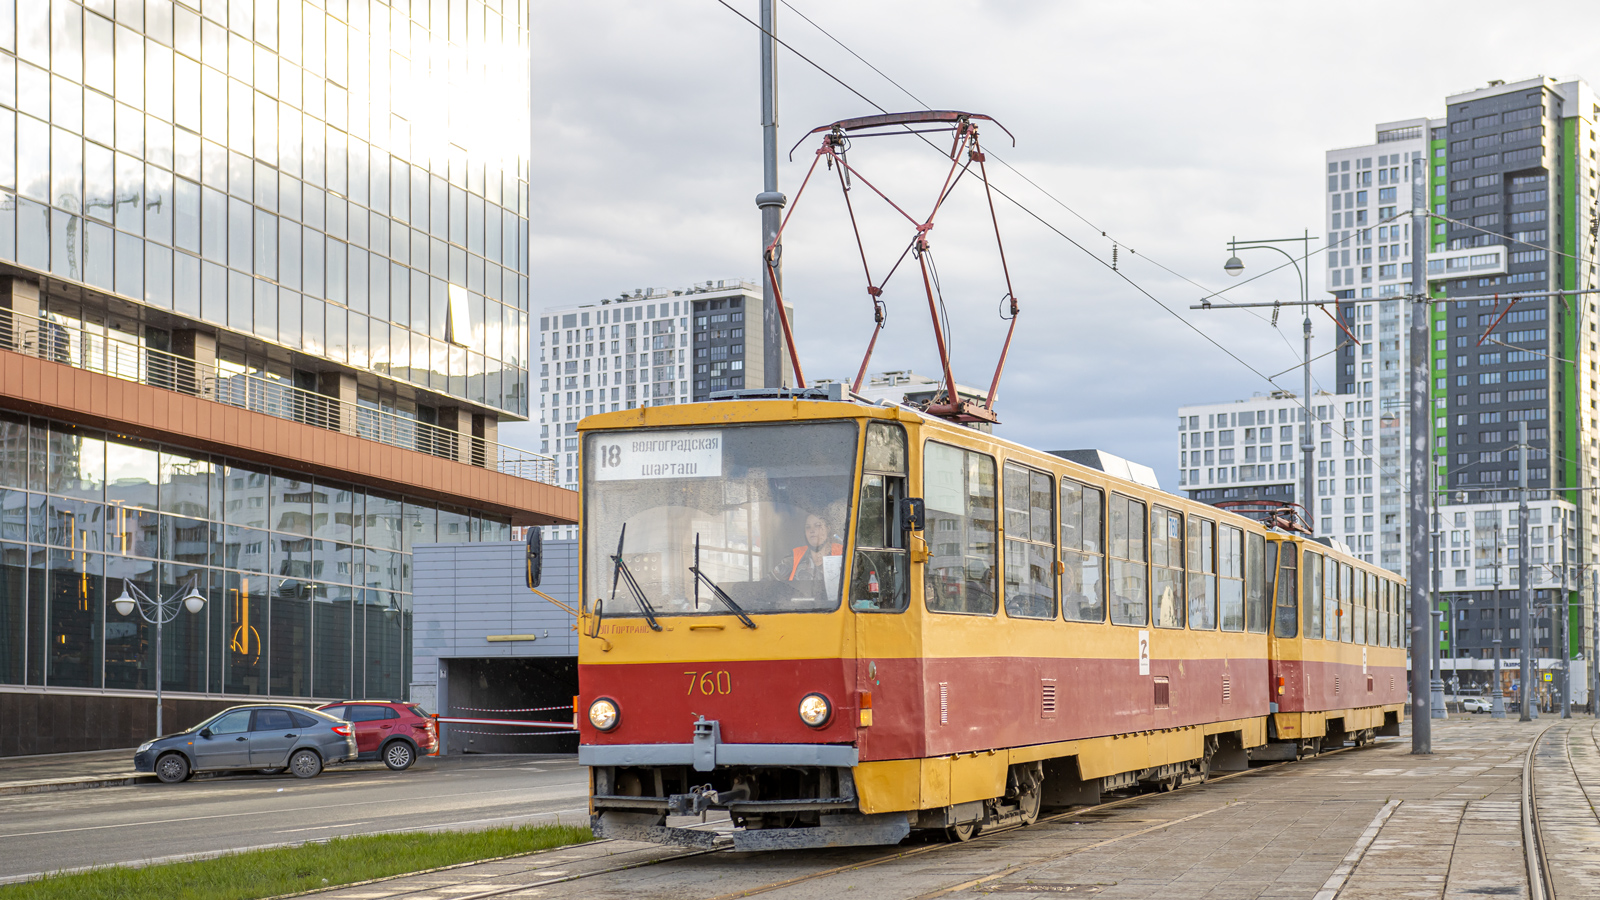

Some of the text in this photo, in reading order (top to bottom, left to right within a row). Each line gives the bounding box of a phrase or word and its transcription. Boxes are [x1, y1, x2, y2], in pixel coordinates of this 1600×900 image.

[601, 444, 622, 468] 18
[641, 462, 698, 476] ШАРТАШ
[1169, 517, 1178, 537] 760
[1140, 639, 1148, 660] 2
[683, 670, 732, 696] 760
